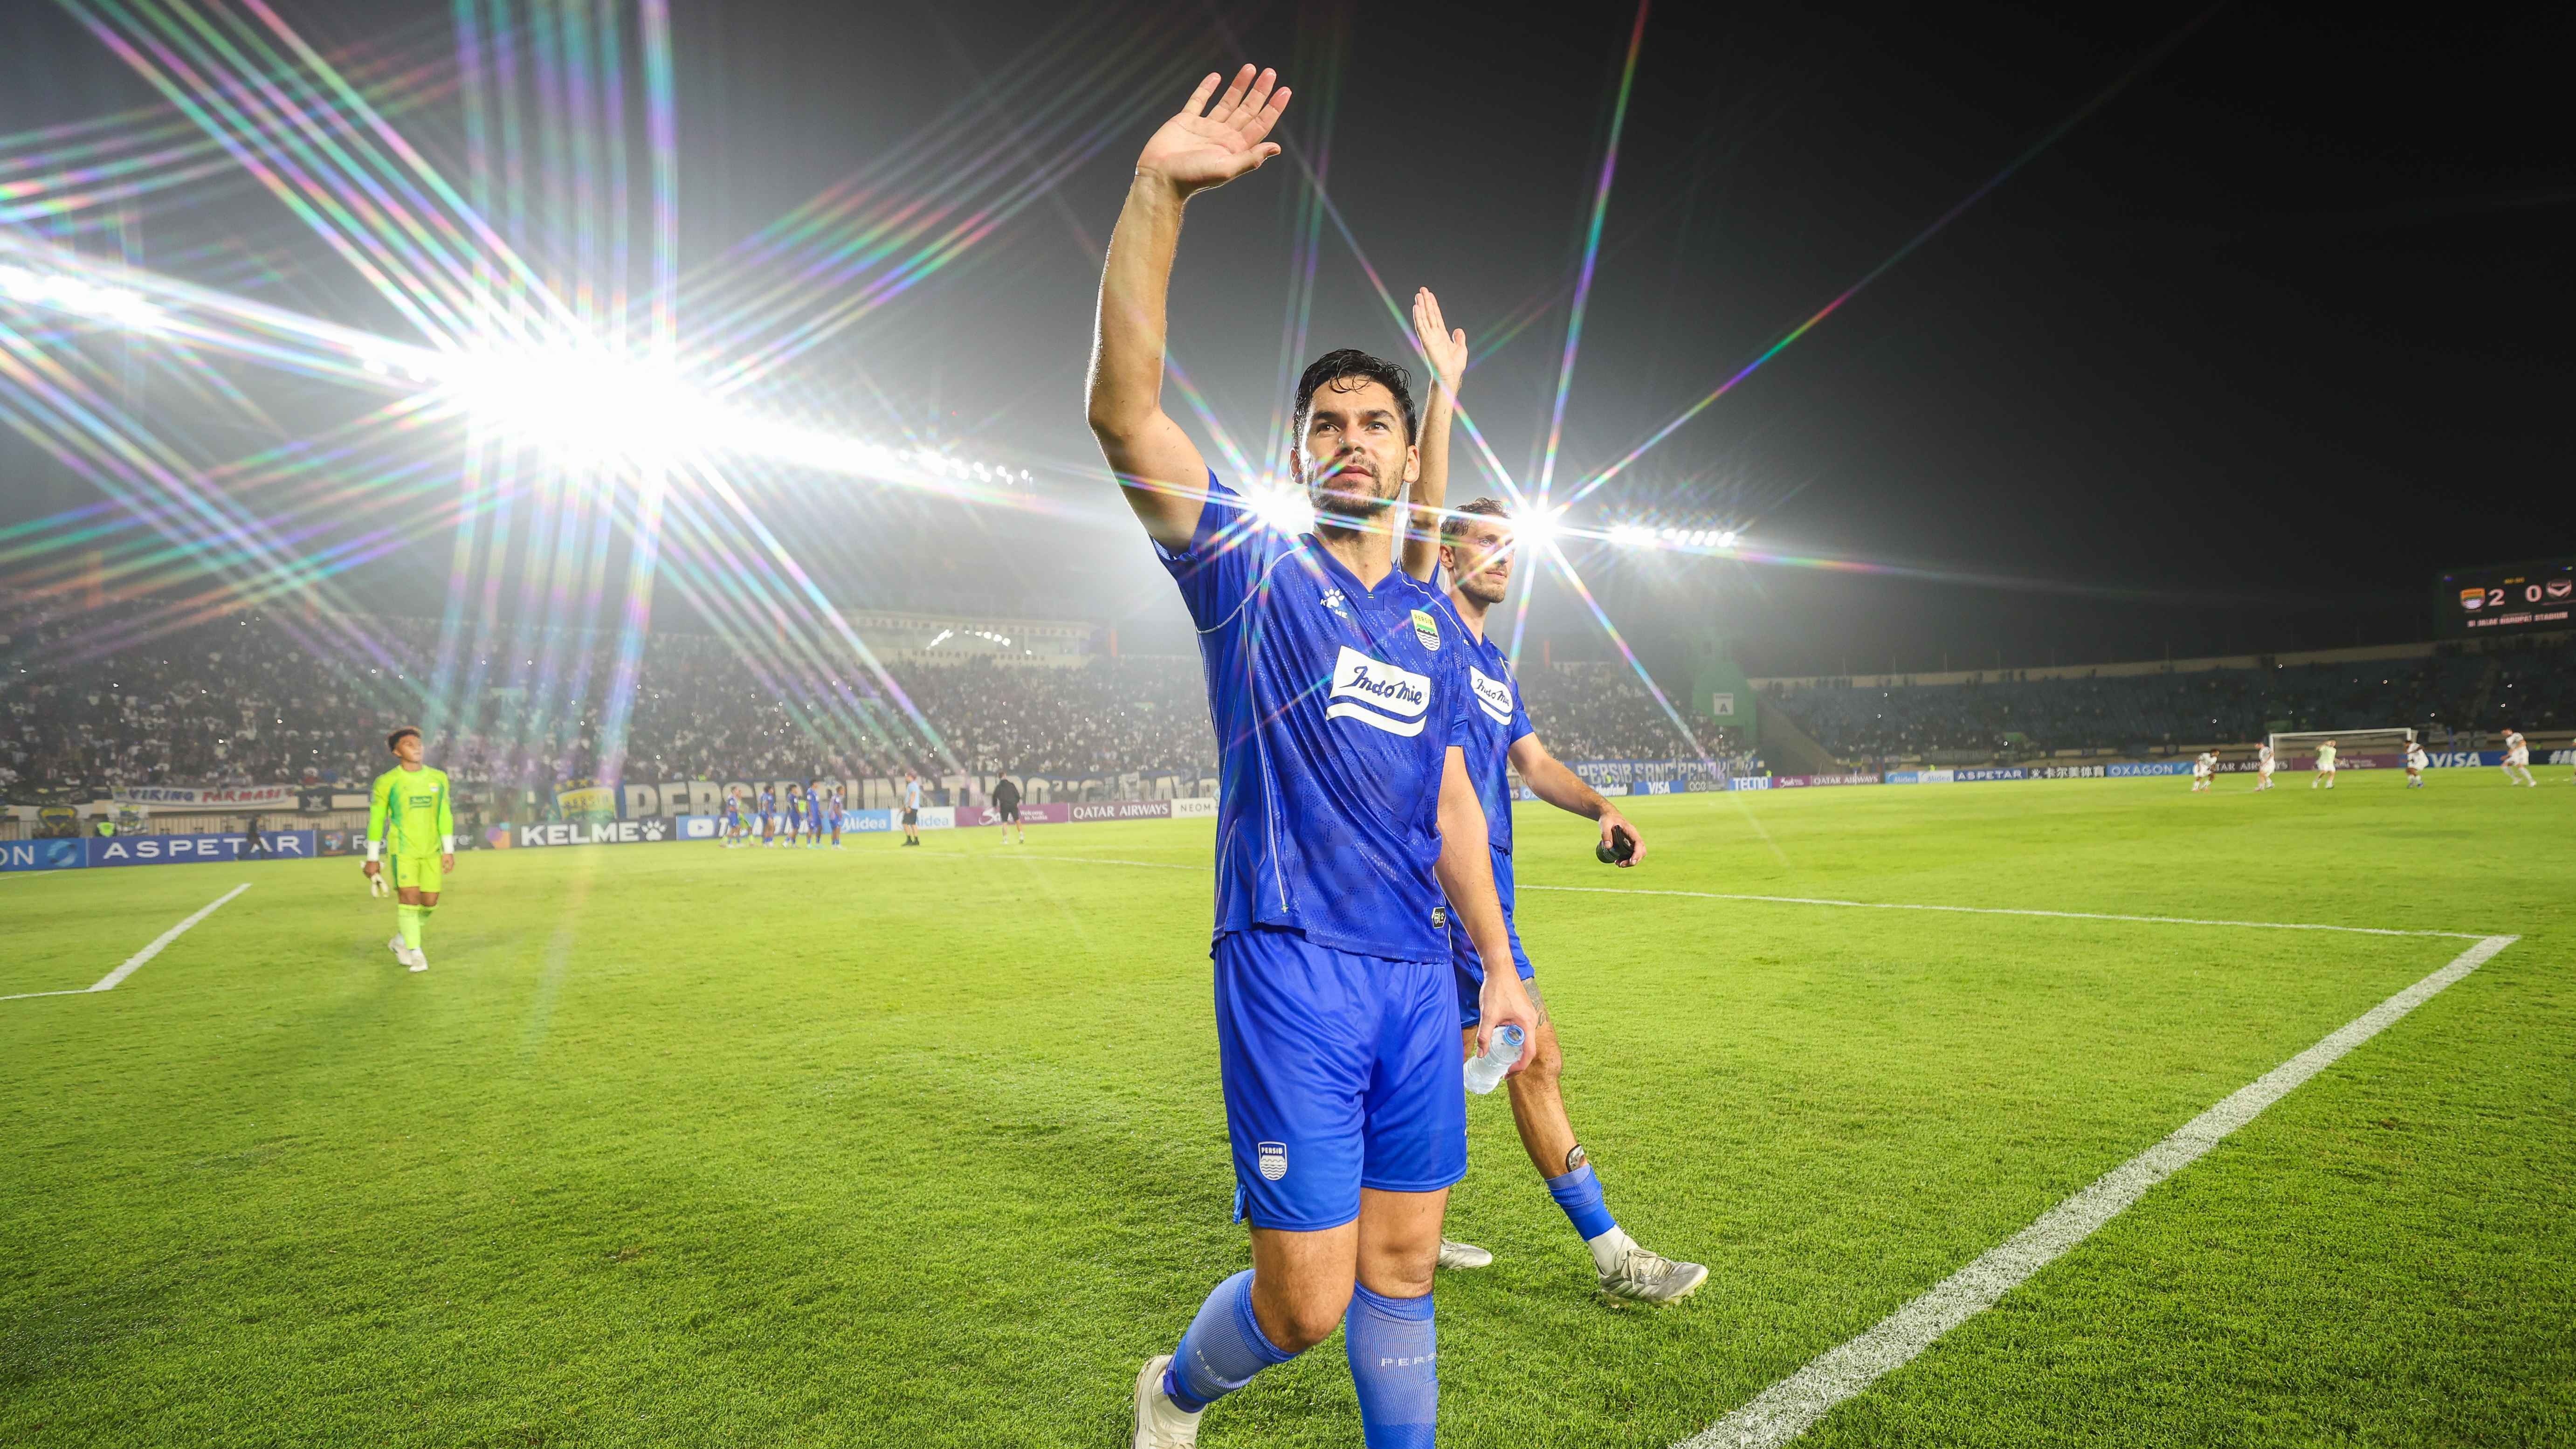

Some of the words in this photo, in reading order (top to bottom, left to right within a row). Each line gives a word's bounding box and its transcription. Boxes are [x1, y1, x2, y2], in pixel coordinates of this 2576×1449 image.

[2487, 588, 2505, 606] 2
[2525, 585, 2542, 602] 0
[1414, 614, 1433, 625] PERSIB
[2429, 752, 2482, 767] VISA
[1577, 763, 1632, 784] PERSIB
[2111, 765, 2173, 776] OXAGON
[2215, 762, 2235, 772] TAR
[1814, 776, 1841, 785] QATAR
[1844, 775, 1878, 784] AIRWAYS
[1958, 770, 2022, 780] ASPETAR
[1646, 781, 1670, 794] VISA
[1733, 777, 1769, 791] TECNO
[129, 788, 194, 801] VIKING
[201, 788, 280, 802] FARMASI
[1073, 805, 1115, 819] QATAR
[1119, 803, 1169, 816] AIRWAYS
[1180, 804, 1211, 812] NEOM
[842, 816, 886, 832] Midea
[916, 815, 949, 828] idea
[521, 821, 640, 846] KELME
[103, 835, 303, 859] ASPETAR
